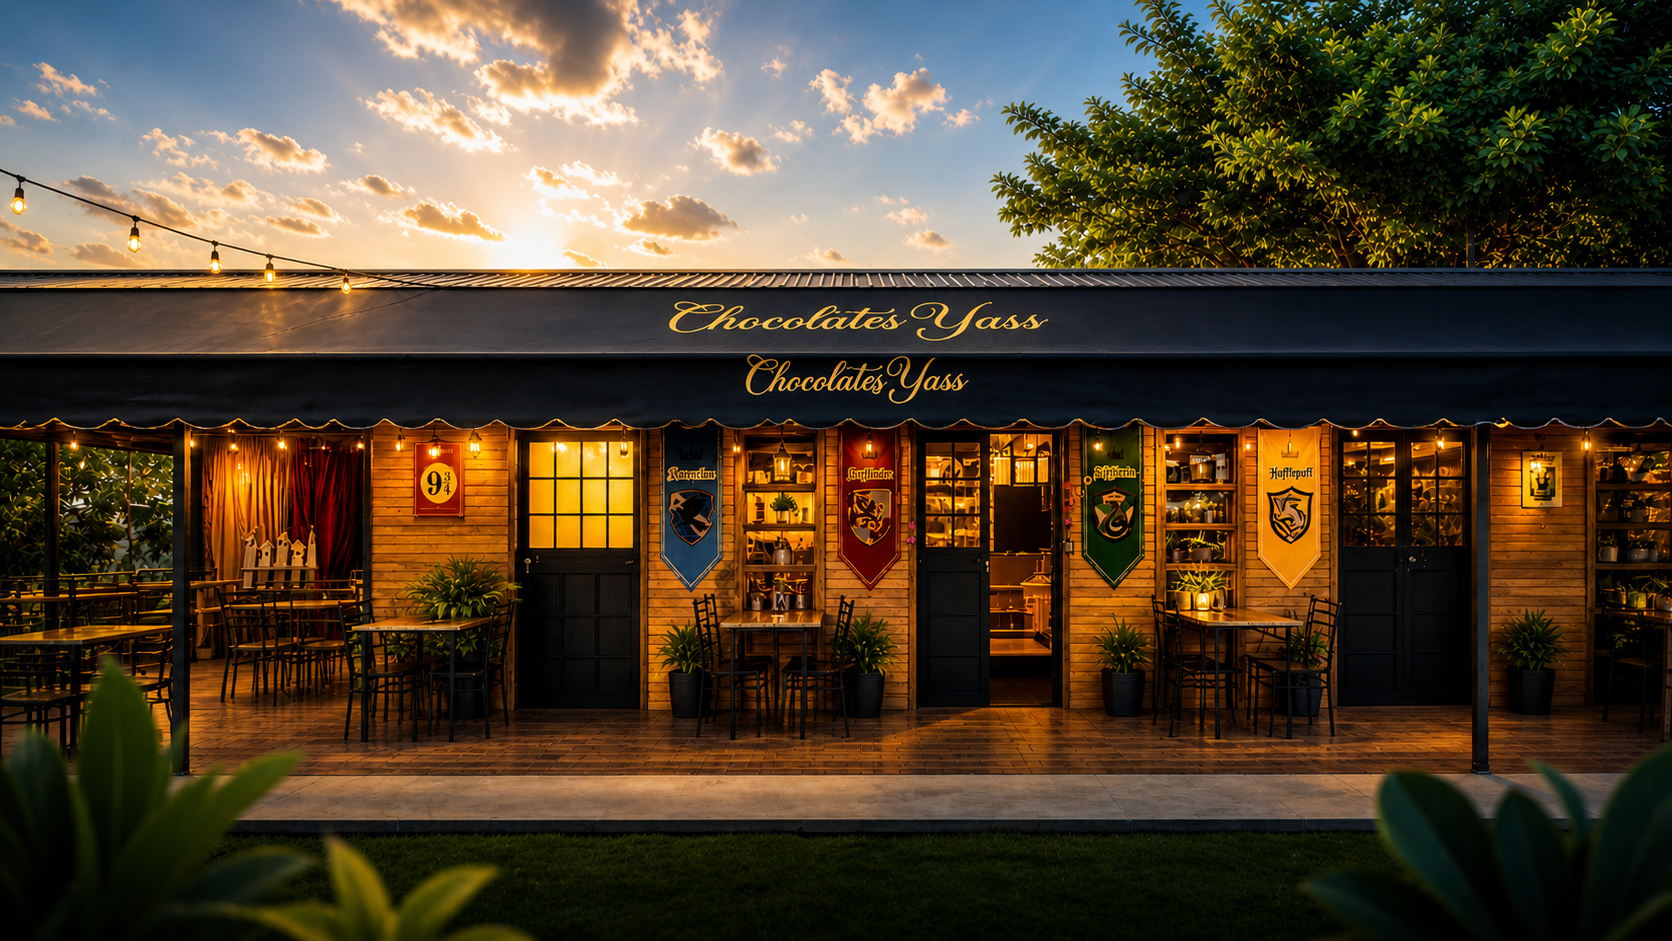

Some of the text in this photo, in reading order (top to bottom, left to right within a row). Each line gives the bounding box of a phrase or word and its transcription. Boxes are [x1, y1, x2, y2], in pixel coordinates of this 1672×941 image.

[669, 301, 1049, 341] Chocolates Yass
[745, 354, 969, 405] Chocolates Yass
